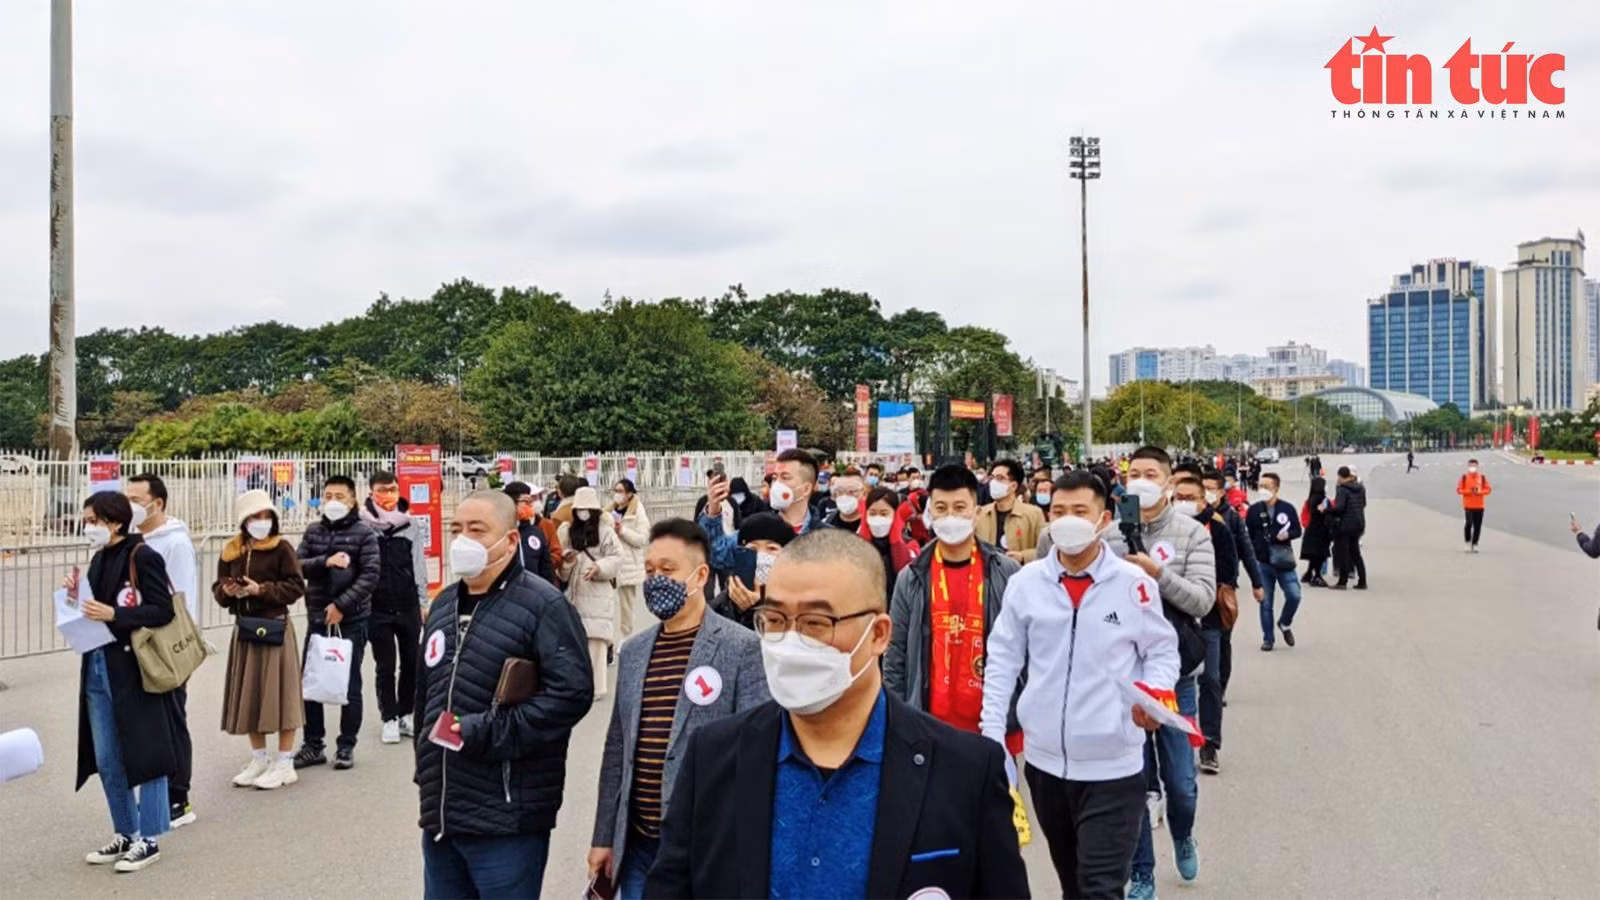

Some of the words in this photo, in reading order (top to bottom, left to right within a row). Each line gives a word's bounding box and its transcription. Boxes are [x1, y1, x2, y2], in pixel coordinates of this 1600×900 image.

[1157, 546, 1169, 561] 1
[1137, 582, 1150, 603] 1
[430, 639, 437, 659] 1
[694, 674, 713, 698] 1
